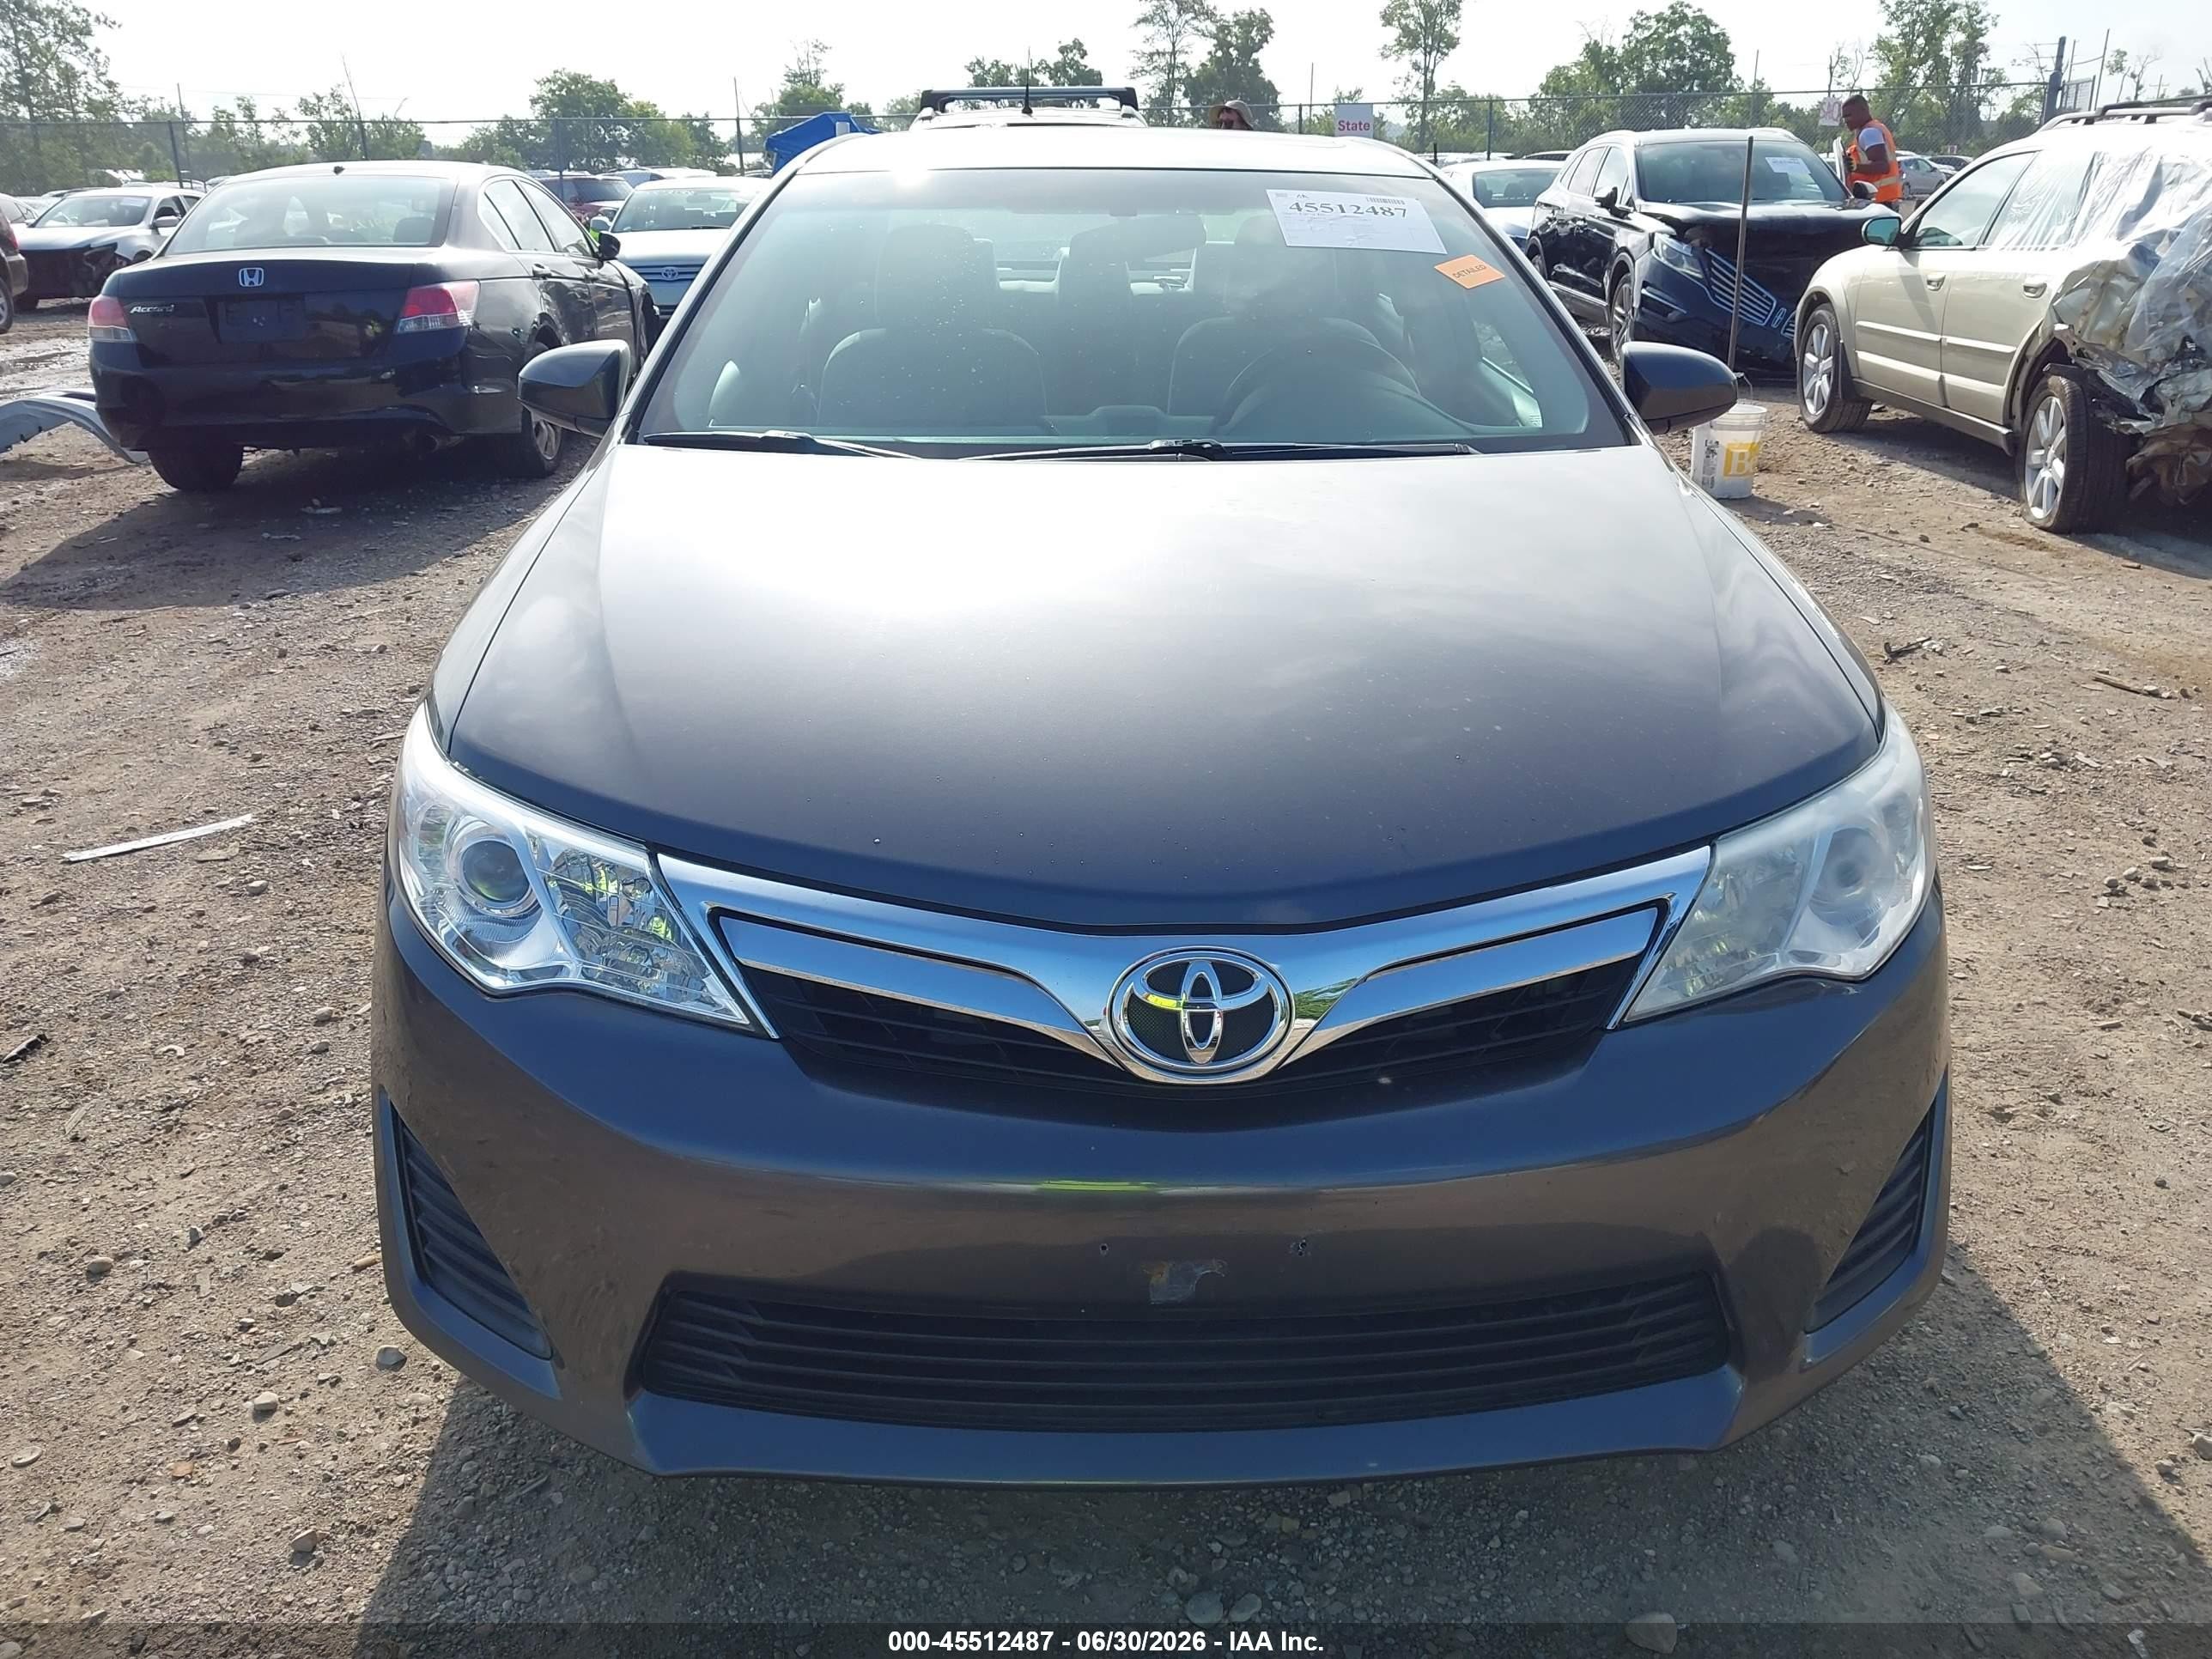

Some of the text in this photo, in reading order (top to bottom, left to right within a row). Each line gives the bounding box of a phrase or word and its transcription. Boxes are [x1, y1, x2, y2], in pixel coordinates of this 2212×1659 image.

[1338, 119, 1370, 131] State
[1288, 201, 1407, 218] 45512487
[1452, 264, 1487, 279] DETAILED
